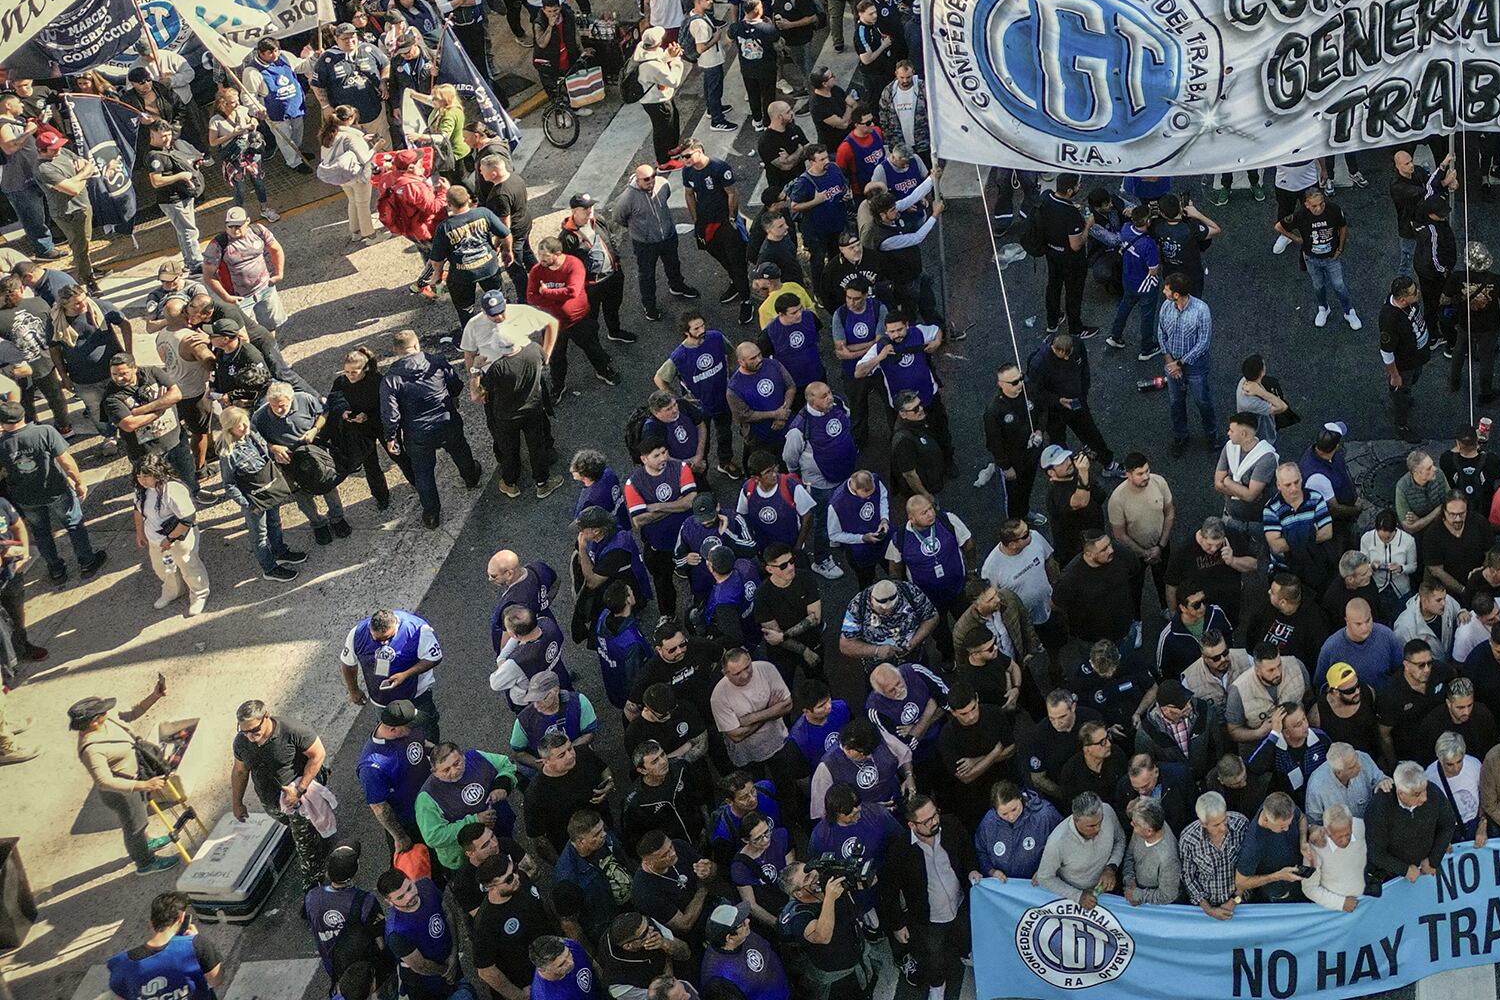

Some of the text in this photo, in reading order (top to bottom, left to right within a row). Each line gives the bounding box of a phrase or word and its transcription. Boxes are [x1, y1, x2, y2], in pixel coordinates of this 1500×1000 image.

[62, 15, 139, 65] CONDUCCIÓN
[1171, 31, 1208, 132] TRABAO
[864, 149, 885, 166] upcn
[1059, 142, 1113, 165] R.A.
[824, 184, 843, 201] pcn
[894, 177, 918, 194] upcn
[1435, 849, 1481, 903] NO
[1038, 917, 1110, 970] CGT
[1231, 946, 1299, 999] NO
[1314, 924, 1405, 993] HAY
